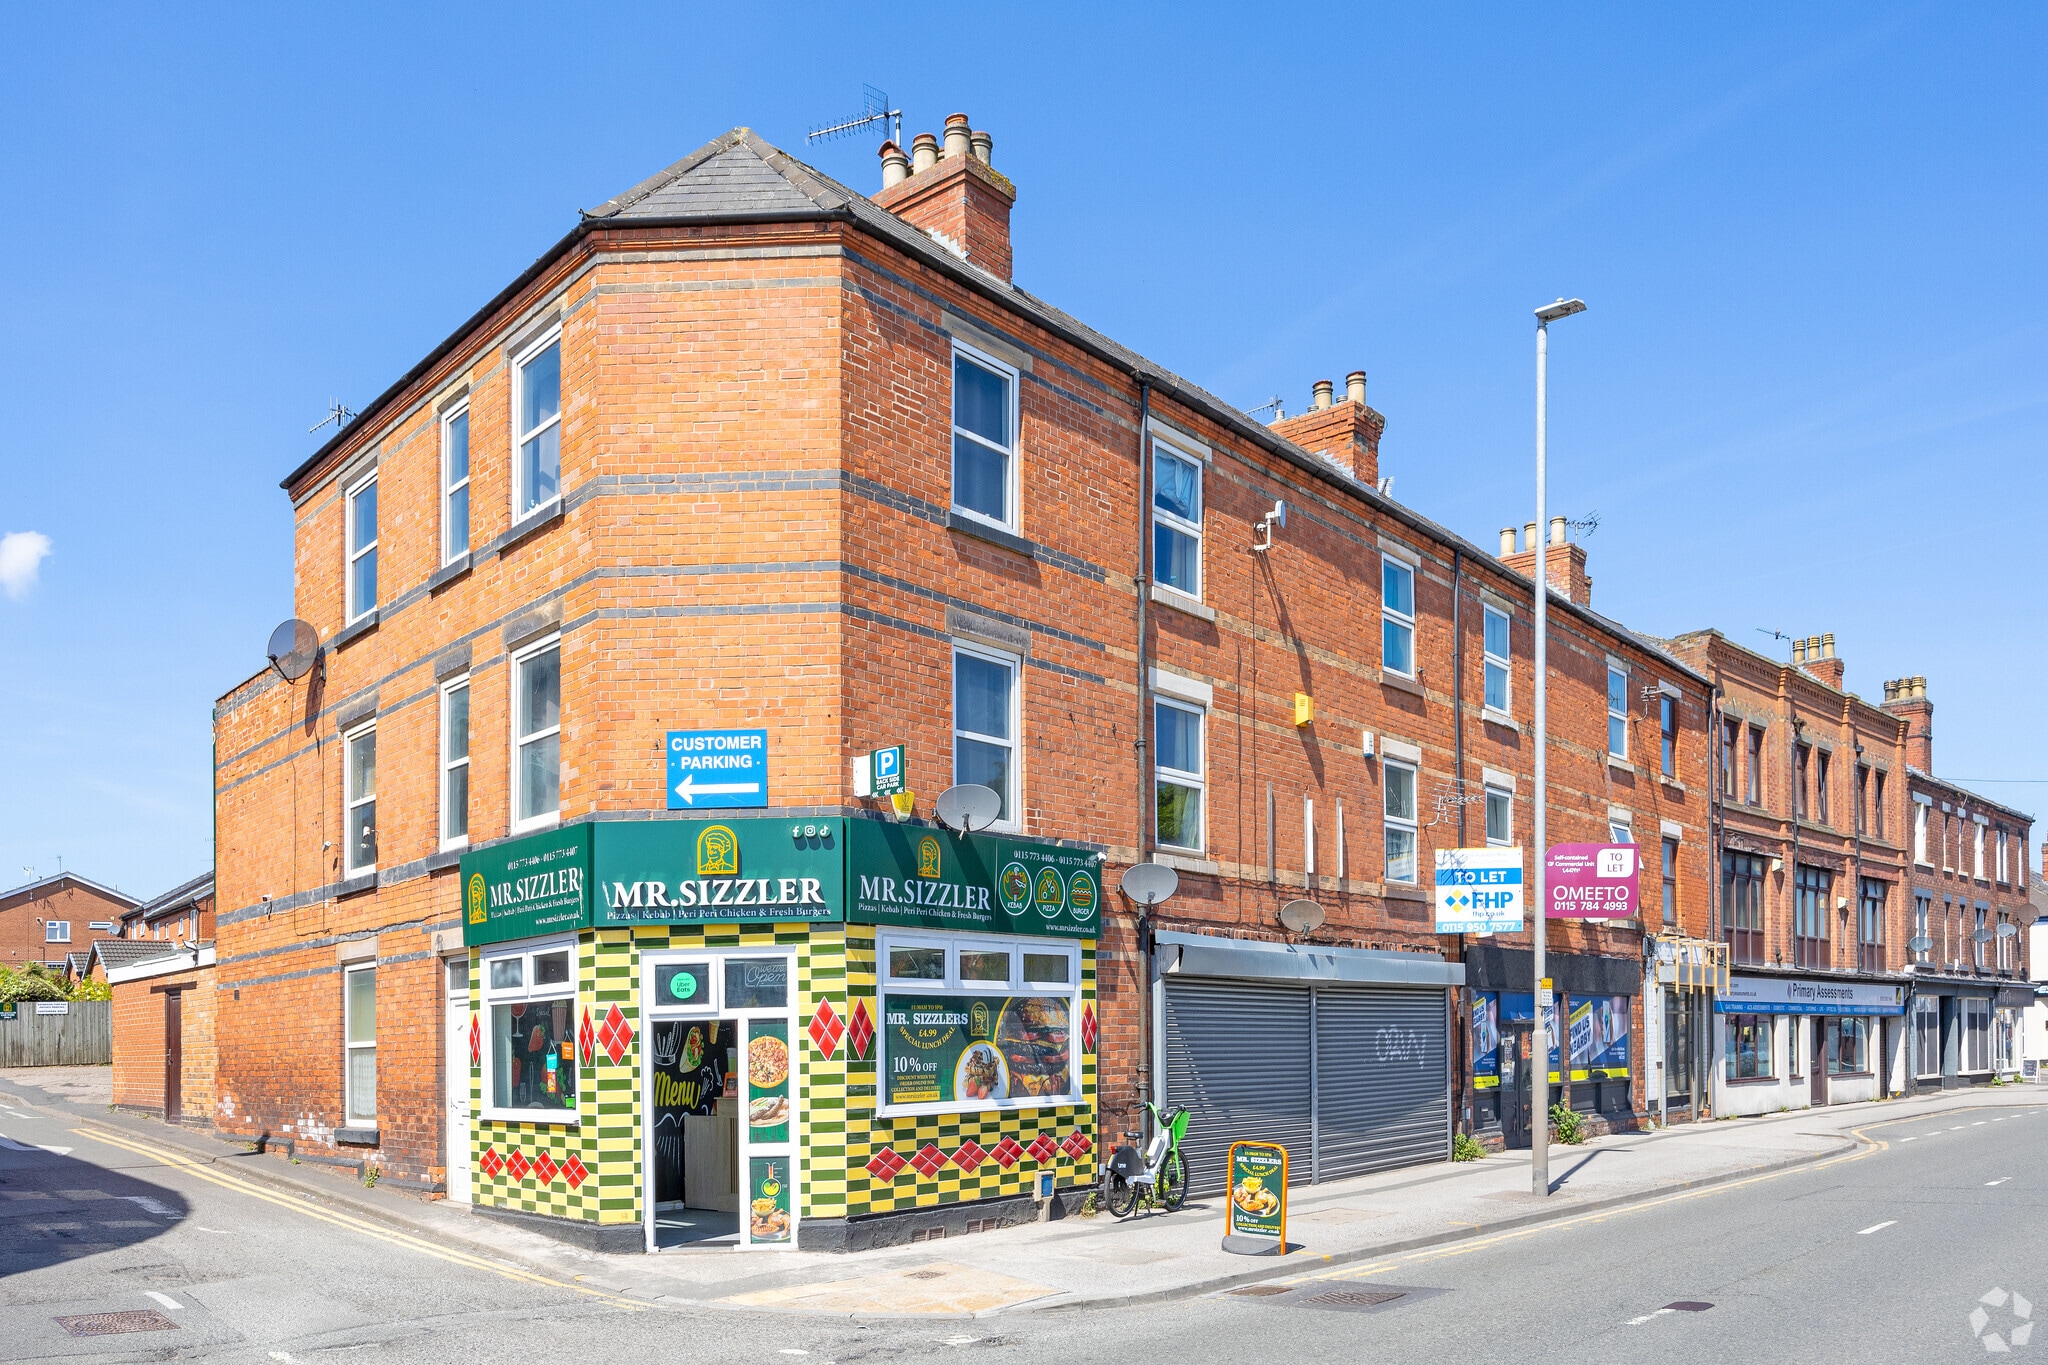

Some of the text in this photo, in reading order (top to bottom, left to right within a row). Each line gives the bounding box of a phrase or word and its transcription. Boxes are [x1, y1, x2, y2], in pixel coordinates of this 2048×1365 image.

[671, 735, 762, 751] CUSTOMER
[681, 754, 753, 770] PARKING
[881, 752, 895, 775] P
[887, 781, 900, 789] PARK
[1013, 850, 1029, 860] 0115
[1029, 851, 1040, 861] 773
[1041, 853, 1055, 863] 4406
[1058, 856, 1073, 865] 0115
[1073, 858, 1084, 867] 773
[1611, 853, 1623, 861] TO
[1607, 864, 1624, 872] LET
[1455, 871, 1507, 883] TO LET
[1472, 891, 1514, 909] FHP
[1553, 885, 1630, 901] OMEETO
[532, 902, 548, 911] Chicken
[552, 898, 563, 907] Fresh
[563, 896, 580, 906] Burgers
[1007, 901, 1023, 909] KEBAB
[1042, 904, 1056, 912] PIZZA
[1072, 907, 1090, 915] BURGER
[1554, 901, 1628, 911] 0115 784 4993
[606, 910, 636, 921] Pizzas
[642, 908, 671, 919] Kebab
[678, 908, 697, 919] Peri
[699, 907, 718, 918] Peri
[719, 907, 757, 918] Chicken
[758, 907, 767, 917] &
[769, 906, 794, 917] Fresh
[795, 906, 832, 918] Burgers
[858, 902, 877, 912] Pizzas
[881, 904, 900, 914] Kebab
[903, 906, 916, 915] Peri
[916, 907, 928, 916] Peri
[928, 908, 951, 918] Chicken
[951, 910, 957, 918] &
[957, 911, 972, 920] Fresh
[972, 912, 992, 922] Burgers
[1472, 910, 1505, 918] fhp.co.uk
[1442, 921, 1516, 933] 0115 950 7577
[747, 966, 787, 987] Open
[1792, 983, 1854, 1001] Primary Assessments
[886, 1012, 969, 1025] MR. SIZZLERS
[1582, 1014, 1590, 1032] US
[899, 1025, 956, 1050] SPECIAL LUNCH DEAL
[918, 1028, 937, 1037] £4.99
[922, 1062, 938, 1072] OFF
[654, 1071, 701, 1110] Menu
